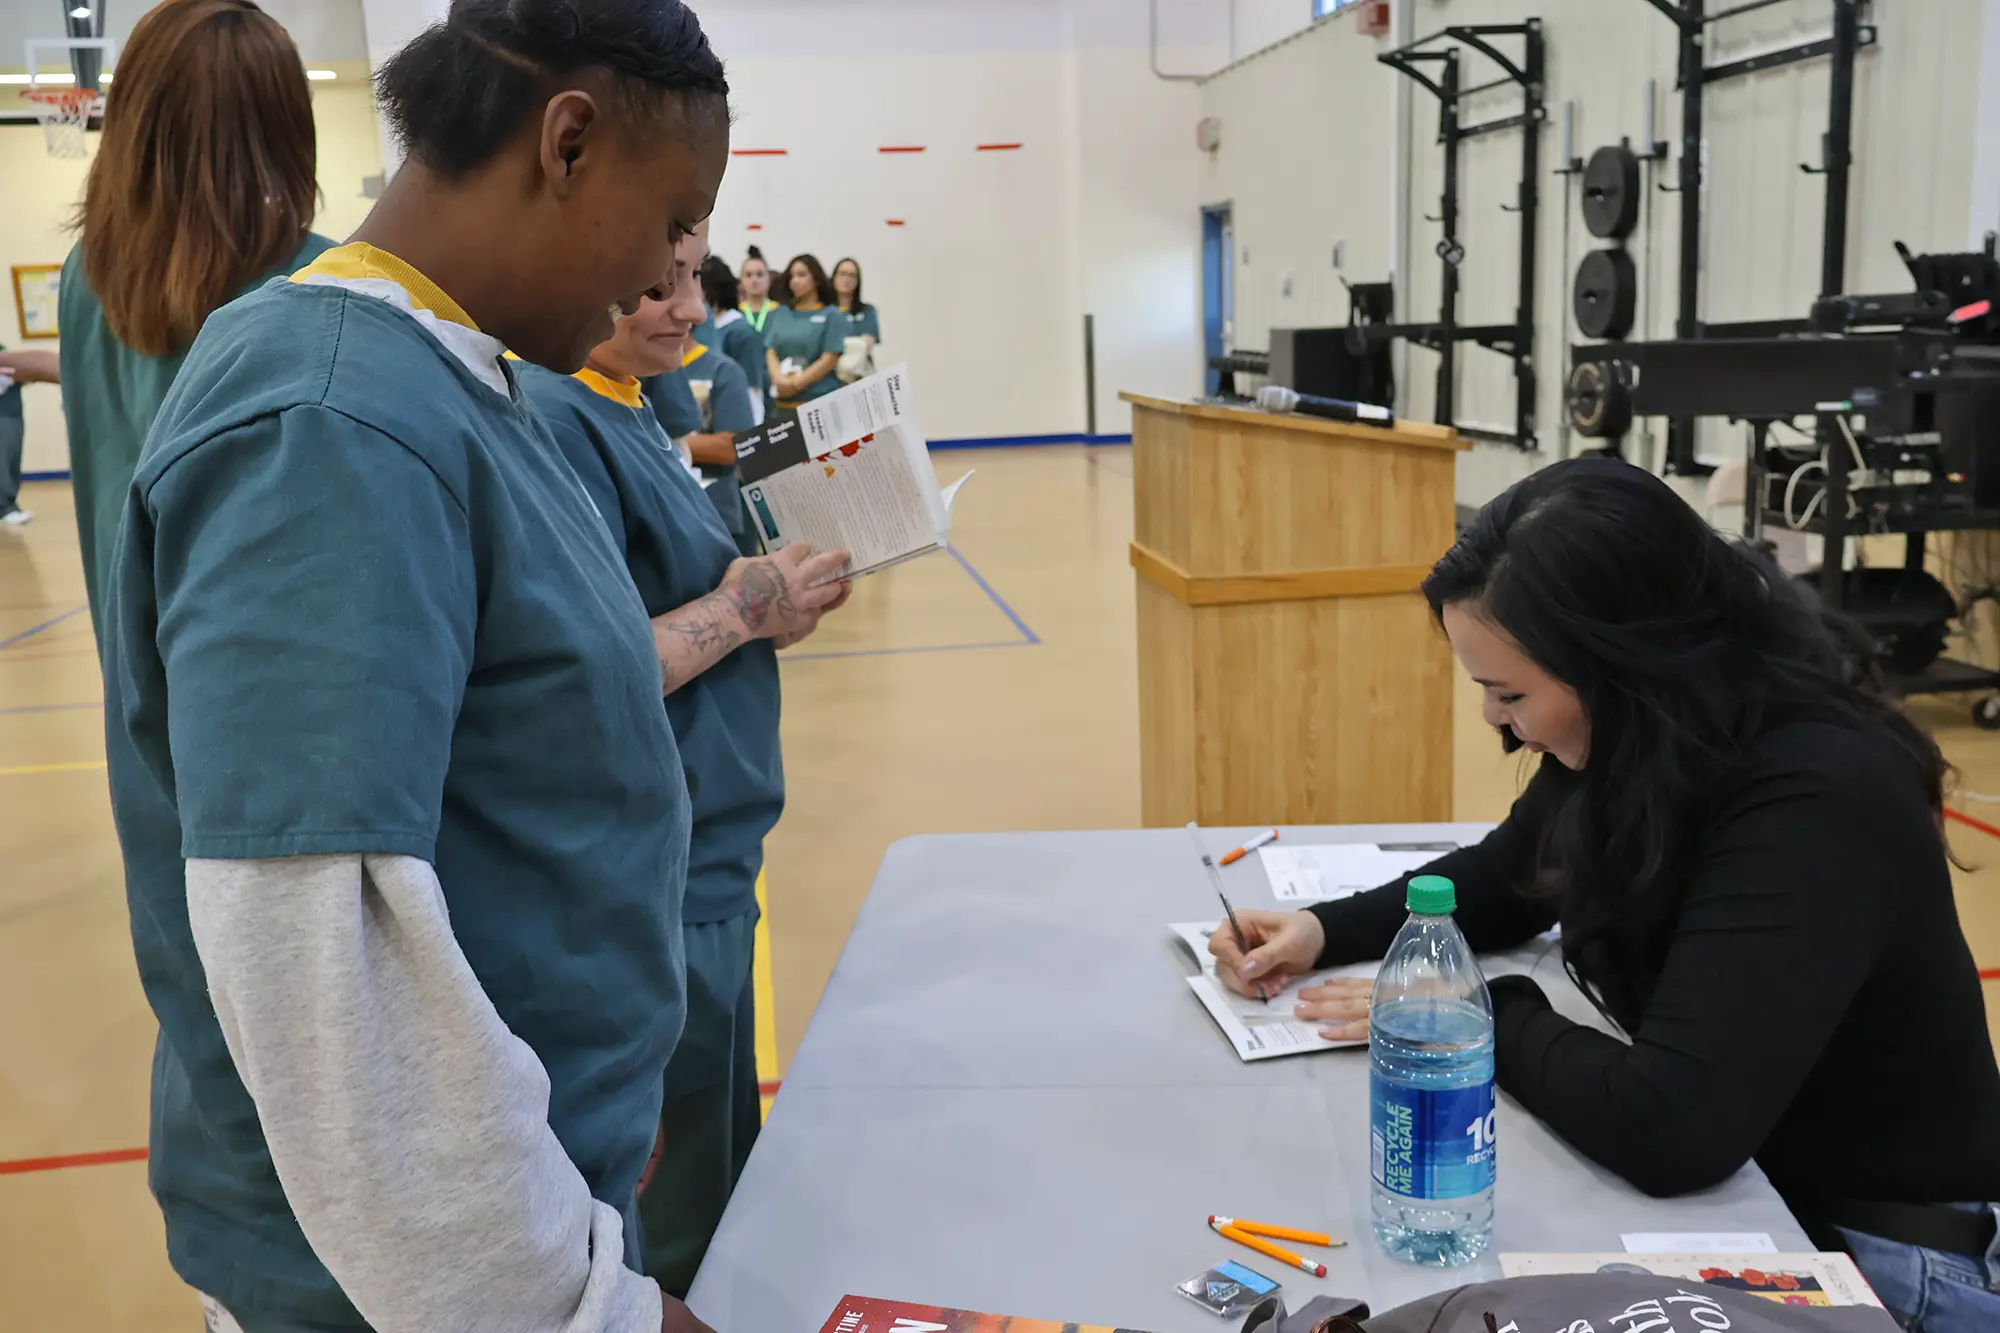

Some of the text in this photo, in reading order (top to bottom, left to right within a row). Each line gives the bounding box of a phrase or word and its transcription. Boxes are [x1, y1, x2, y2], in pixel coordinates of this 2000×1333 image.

[886, 377, 900, 416] Connected
[766, 420, 795, 437] Freedom
[768, 431, 789, 444] Reads
[813, 408, 825, 440] Freedom
[1386, 1101, 1399, 1190] RECYCLE
[1399, 1106, 1413, 1194] ME AGAIN
[834, 1310, 864, 1333] TINE
